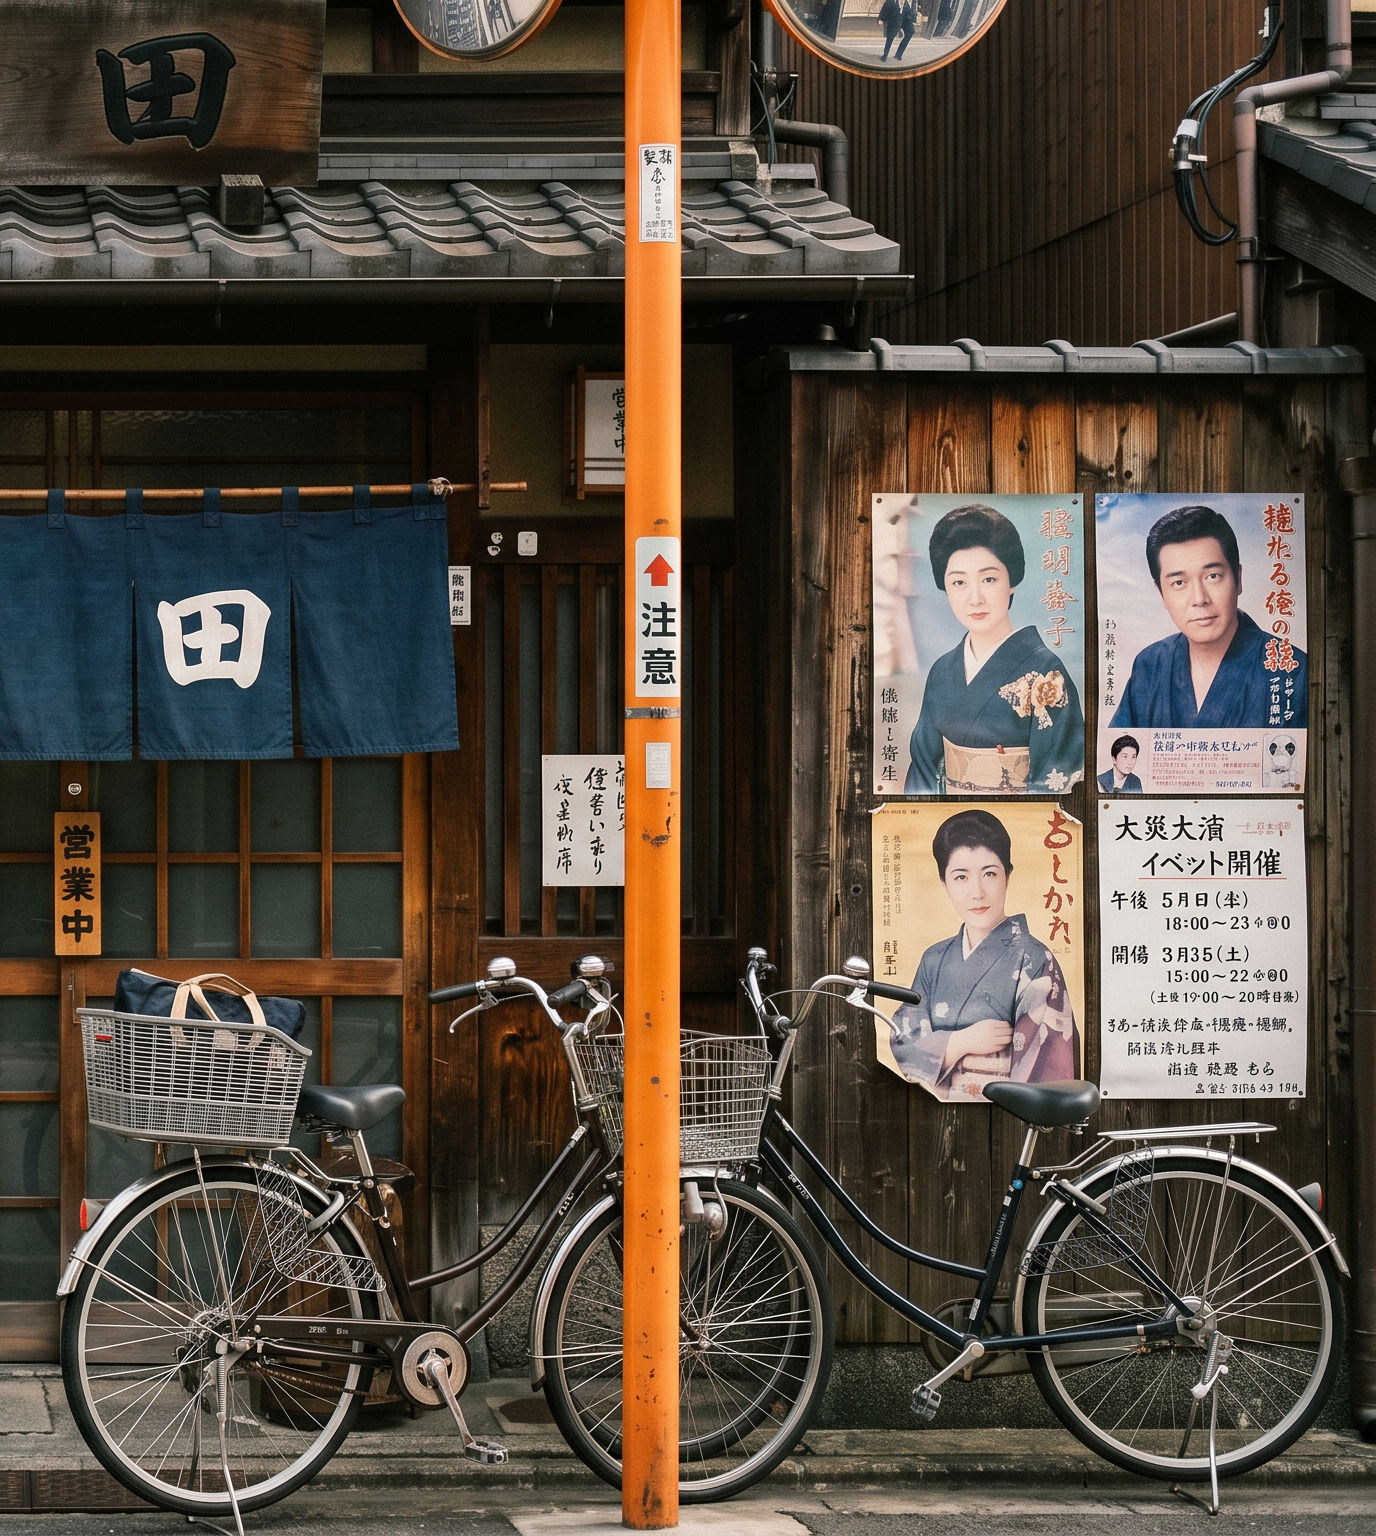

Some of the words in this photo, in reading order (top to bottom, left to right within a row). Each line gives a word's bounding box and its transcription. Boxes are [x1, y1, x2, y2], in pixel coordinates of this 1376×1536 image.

[642, 601, 676, 685] 注意
[60, 824, 95, 943] 営業中
[1111, 890, 1149, 910] 午後
